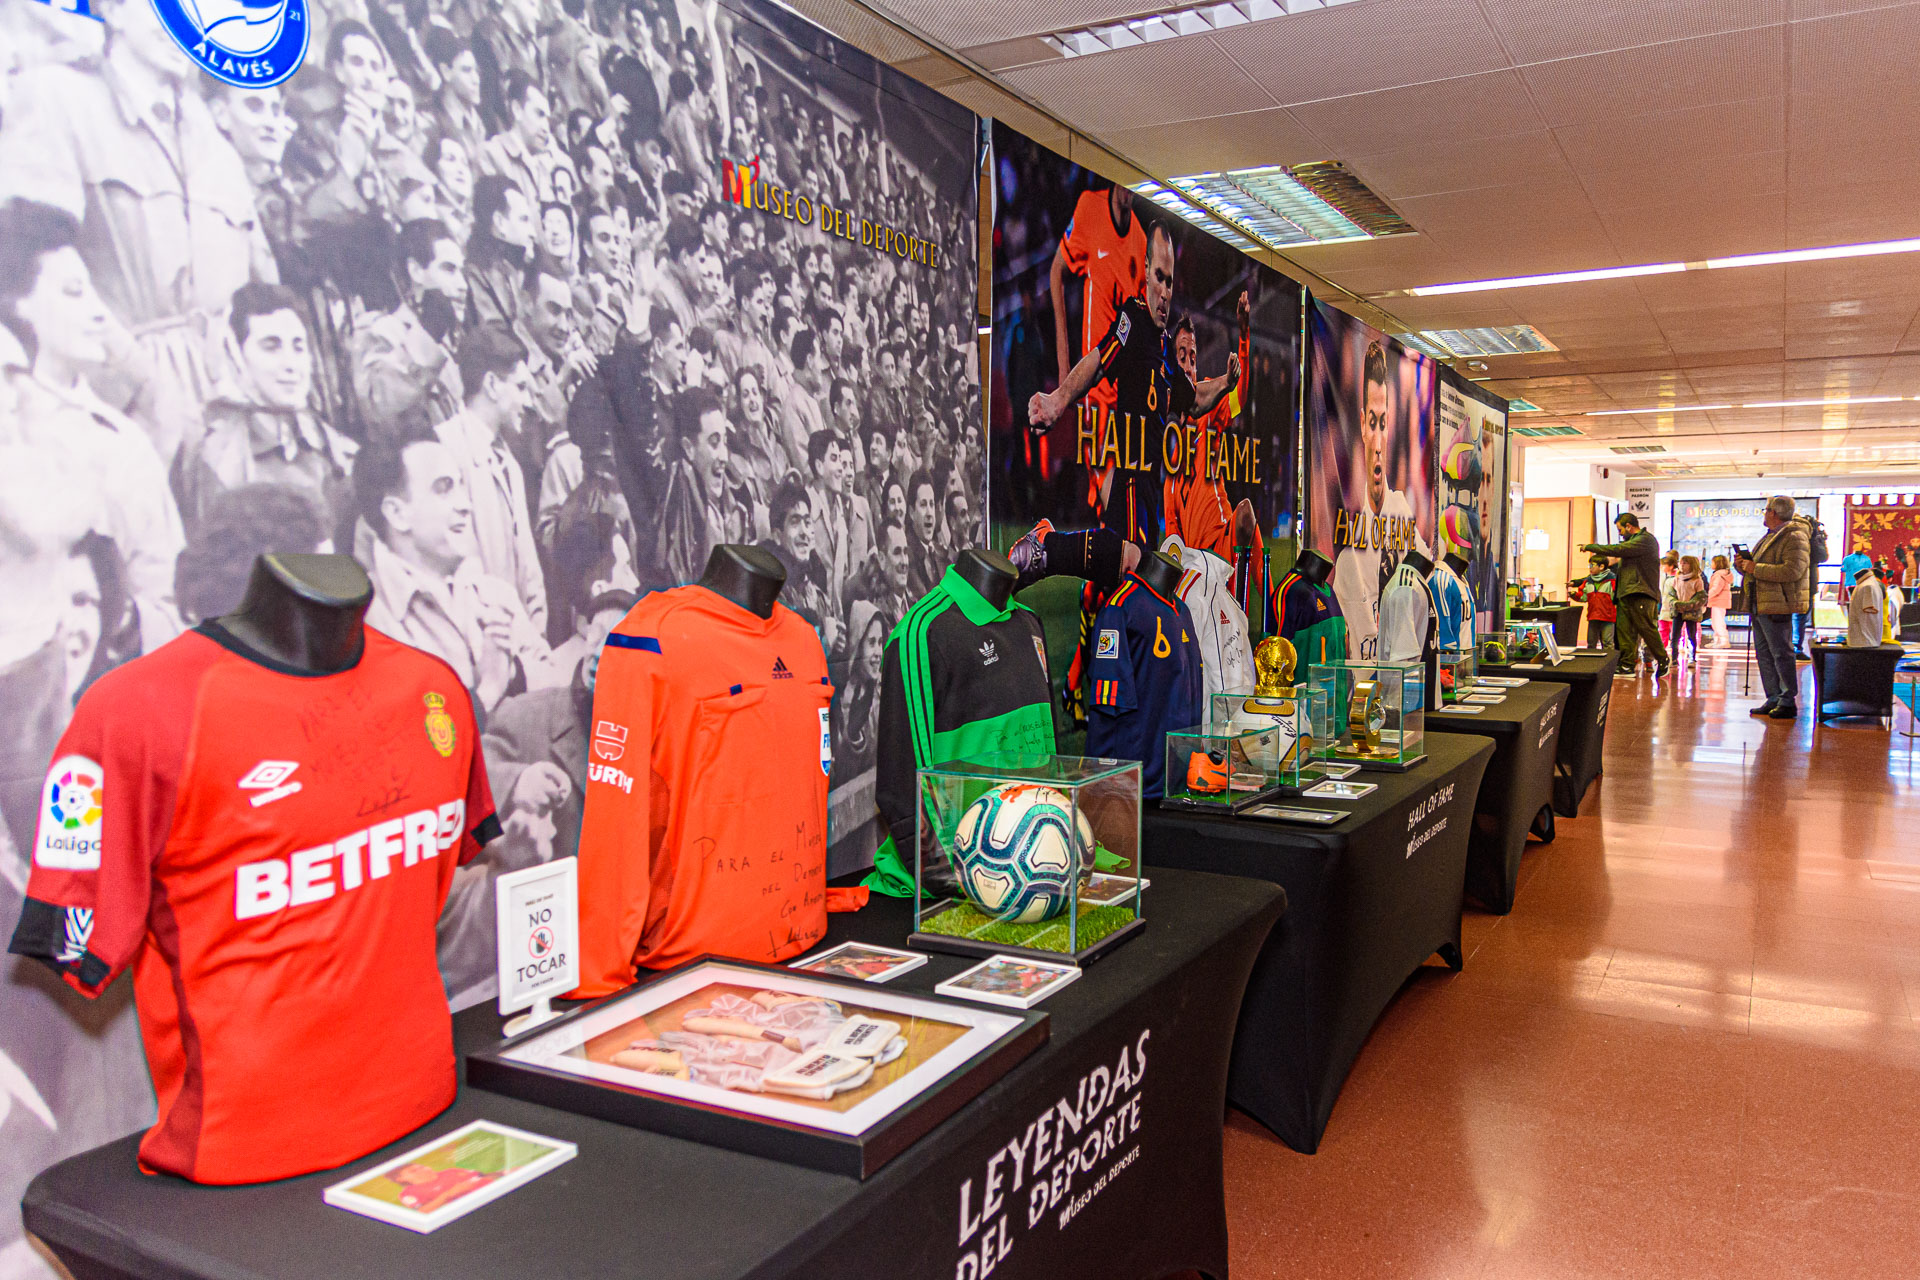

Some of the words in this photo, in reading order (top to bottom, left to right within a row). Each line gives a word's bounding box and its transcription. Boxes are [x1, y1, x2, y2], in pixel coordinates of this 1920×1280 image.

[288, 10, 301, 21] 21
[192, 41, 275, 78] ALAVÉS
[721, 156, 813, 225] MUSEO
[820, 204, 856, 241] DEL
[861, 218, 939, 268] DEPORTE
[1076, 403, 1153, 472] HALL
[1162, 421, 1198, 476] OF
[1205, 428, 1262, 484] FAME
[1731, 506, 1750, 517] DEL
[1371, 515, 1387, 550] OF
[1390, 516, 1417, 550] FAME
[1153, 616, 1171, 658] 6
[1407, 800, 1426, 831] HALL
[529, 908, 552, 927] NO
[516, 953, 567, 983] TOCAR
[958, 1028, 1150, 1247] LEYENDAS
[956, 1213, 1014, 1280] DEL
[1028, 1092, 1142, 1229] DEPORTE
[1059, 1189, 1092, 1230] MUSEO
[1093, 1174, 1107, 1196] DEL
[1109, 1144, 1140, 1182] DEPORTE
